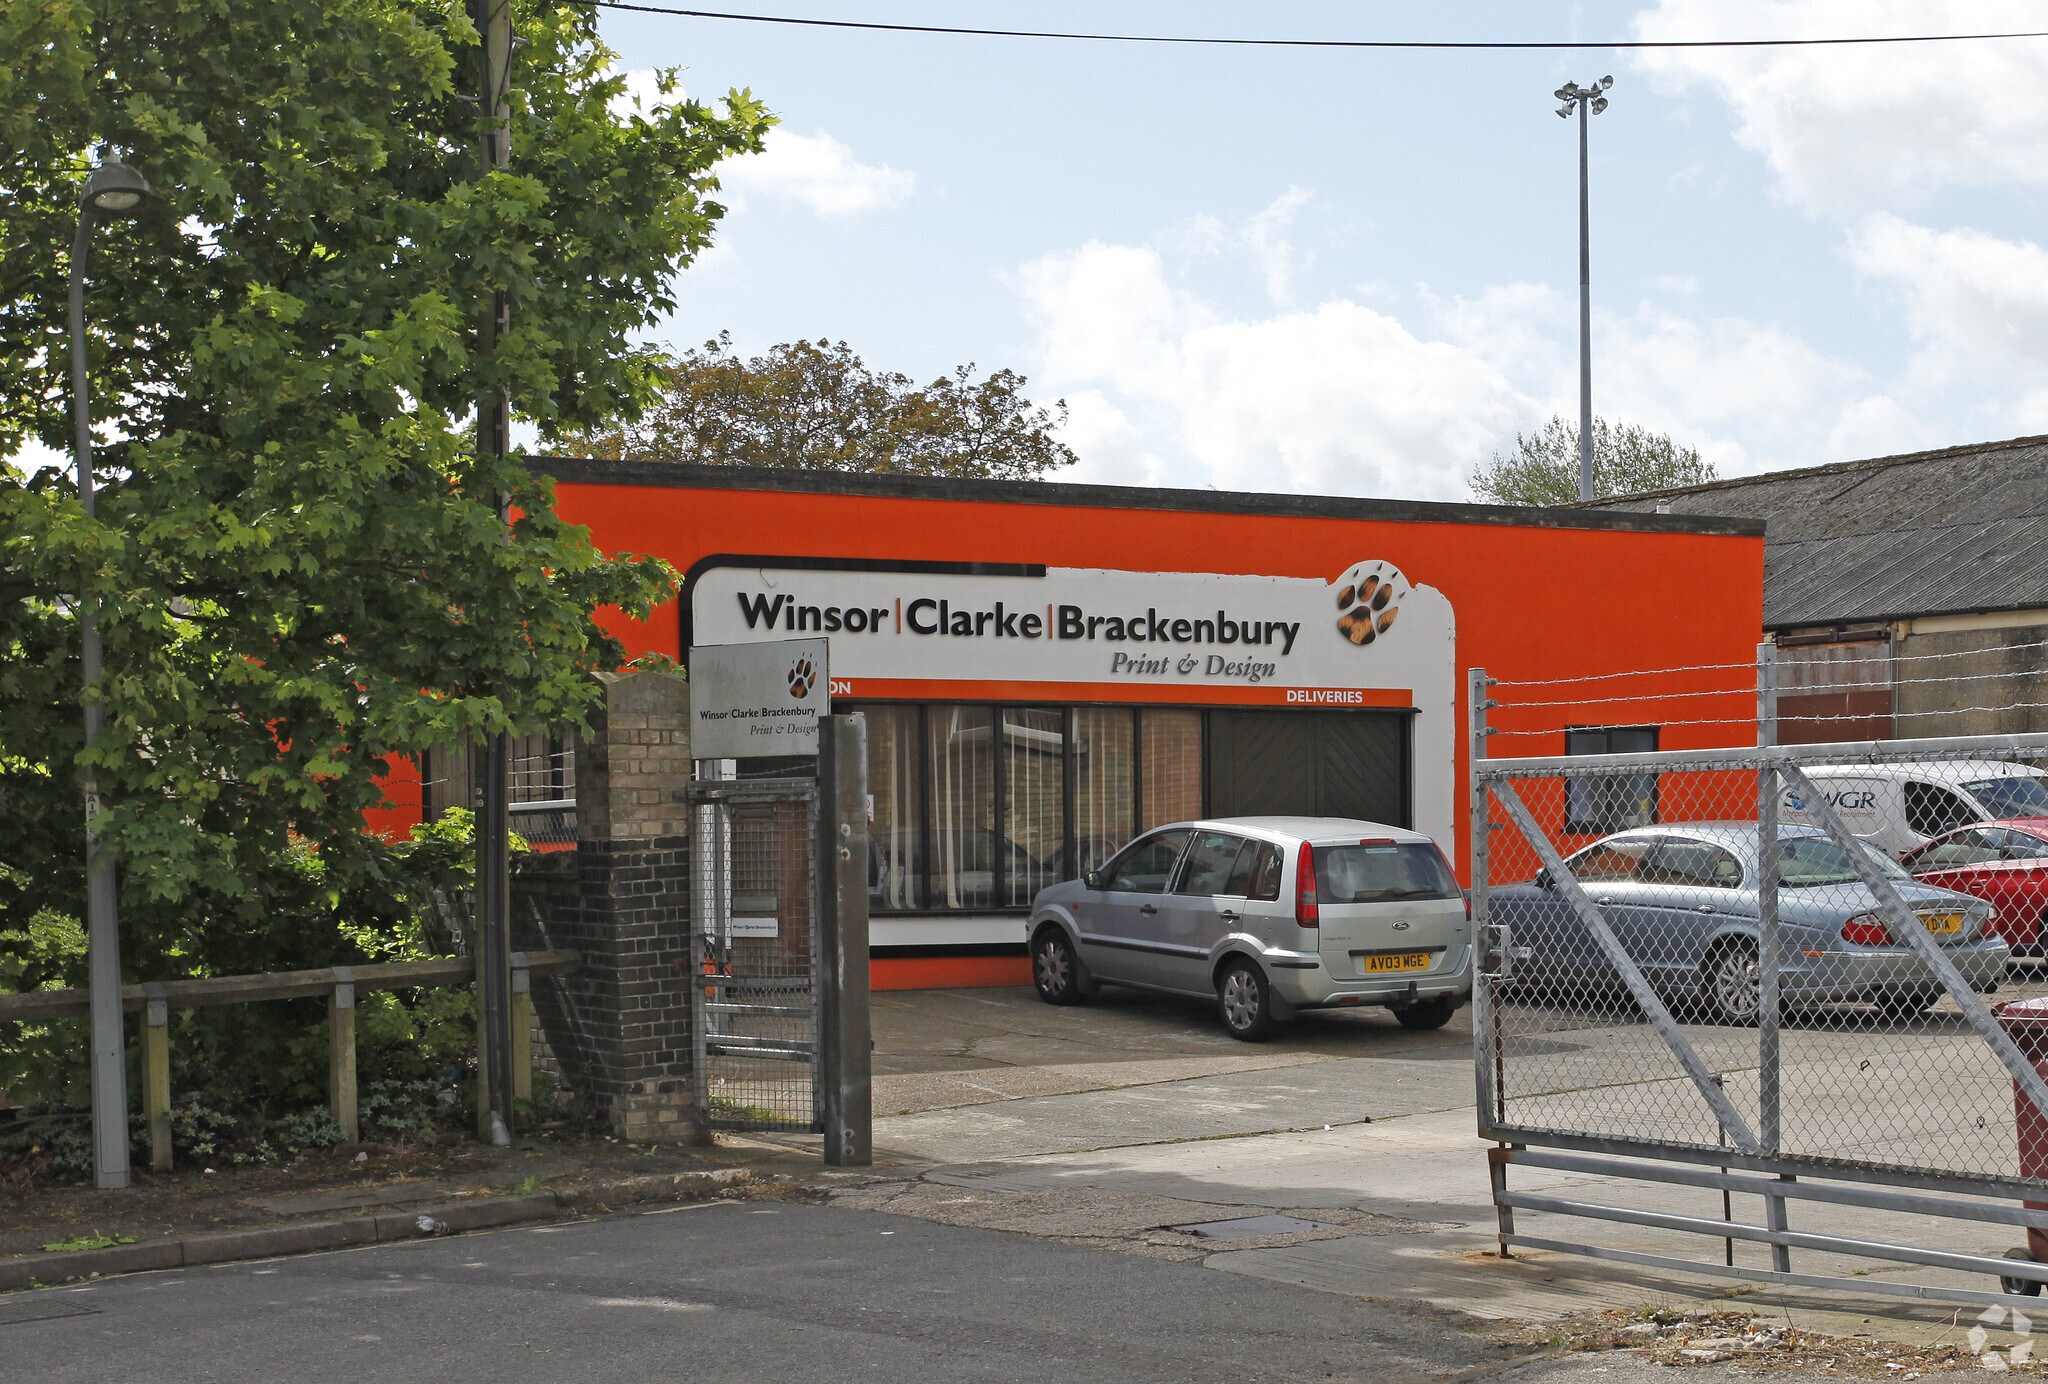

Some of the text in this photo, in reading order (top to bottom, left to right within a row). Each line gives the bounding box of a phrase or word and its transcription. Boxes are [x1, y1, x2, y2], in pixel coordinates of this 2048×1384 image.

[738, 592, 1301, 656] Winsor Clarke Brackenbury
[1111, 651, 1276, 682] Print & Design
[1286, 690, 1363, 703] DELIVERIES
[700, 706, 816, 721] Winsor Clarke Brackenbury
[750, 723, 817, 737] Print & Design
[1371, 955, 1424, 970] AV03 MGE
